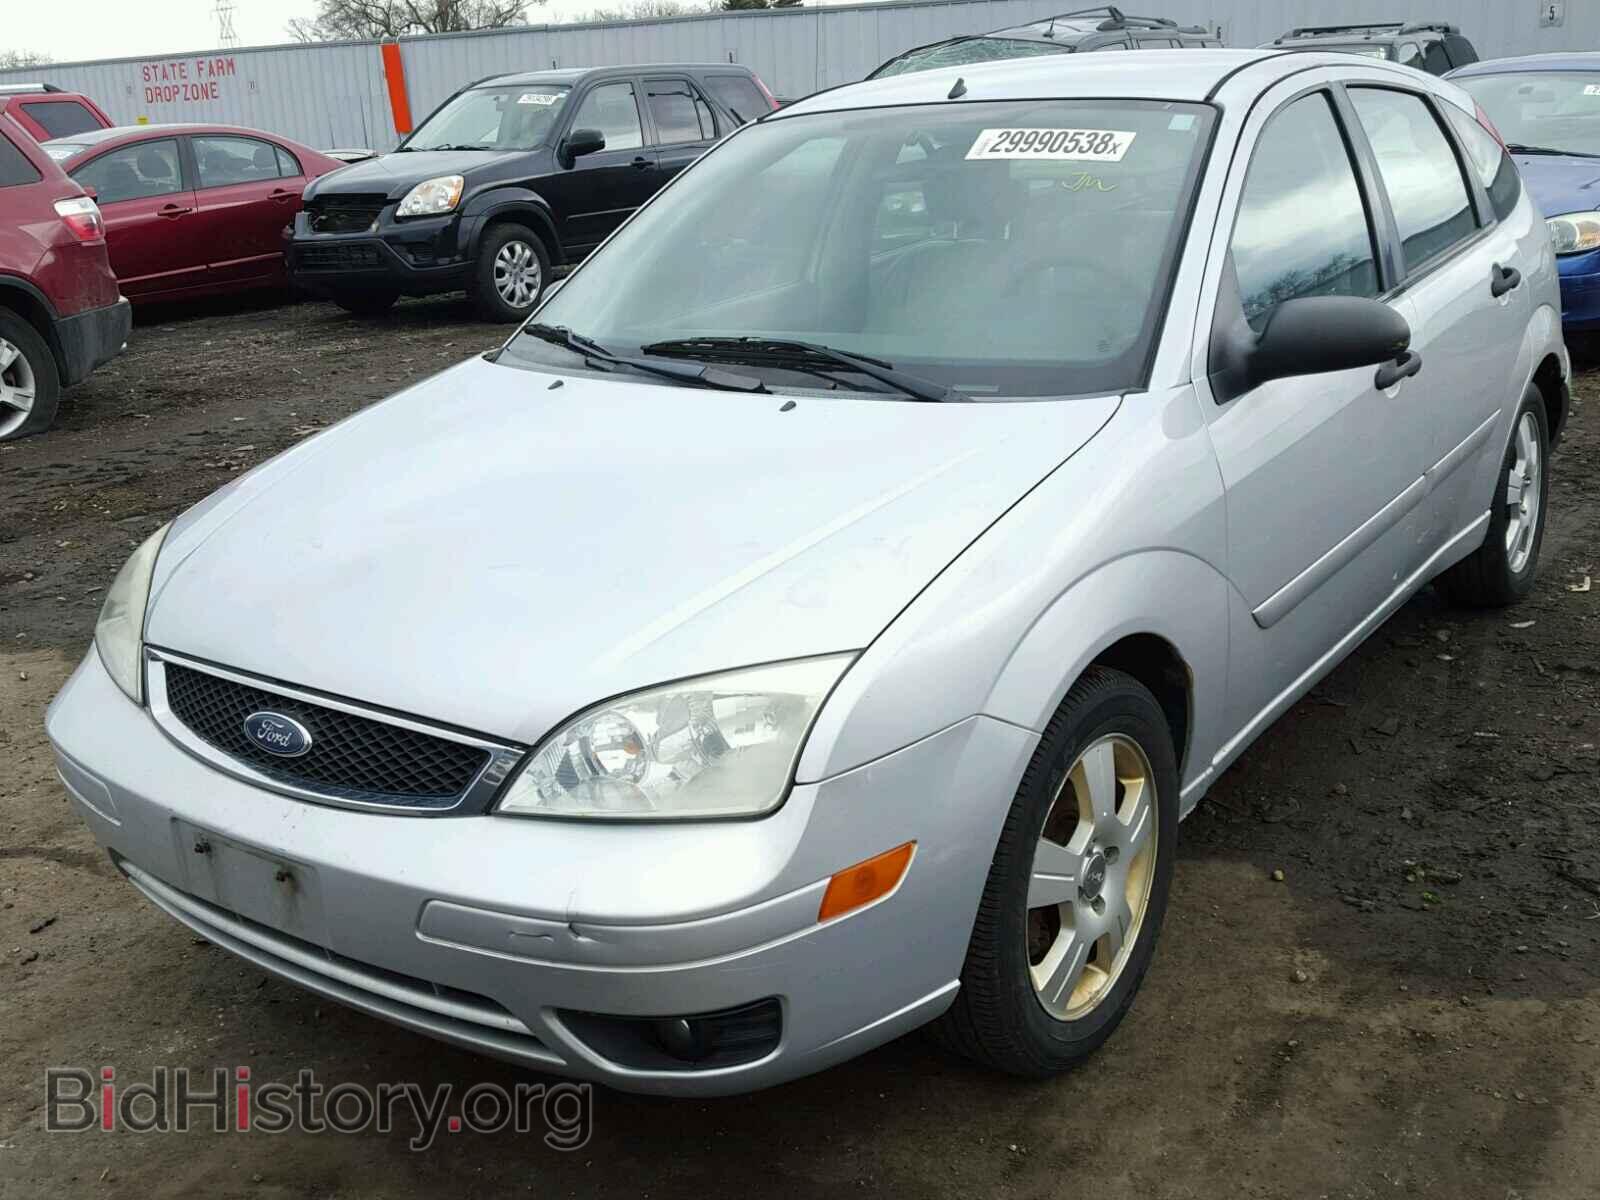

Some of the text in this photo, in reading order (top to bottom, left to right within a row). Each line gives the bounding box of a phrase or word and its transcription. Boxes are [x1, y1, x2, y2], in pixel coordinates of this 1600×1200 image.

[142, 57, 236, 82] STATE FARM
[144, 81, 220, 104] DROPZONE
[257, 719, 292, 747] Ford
